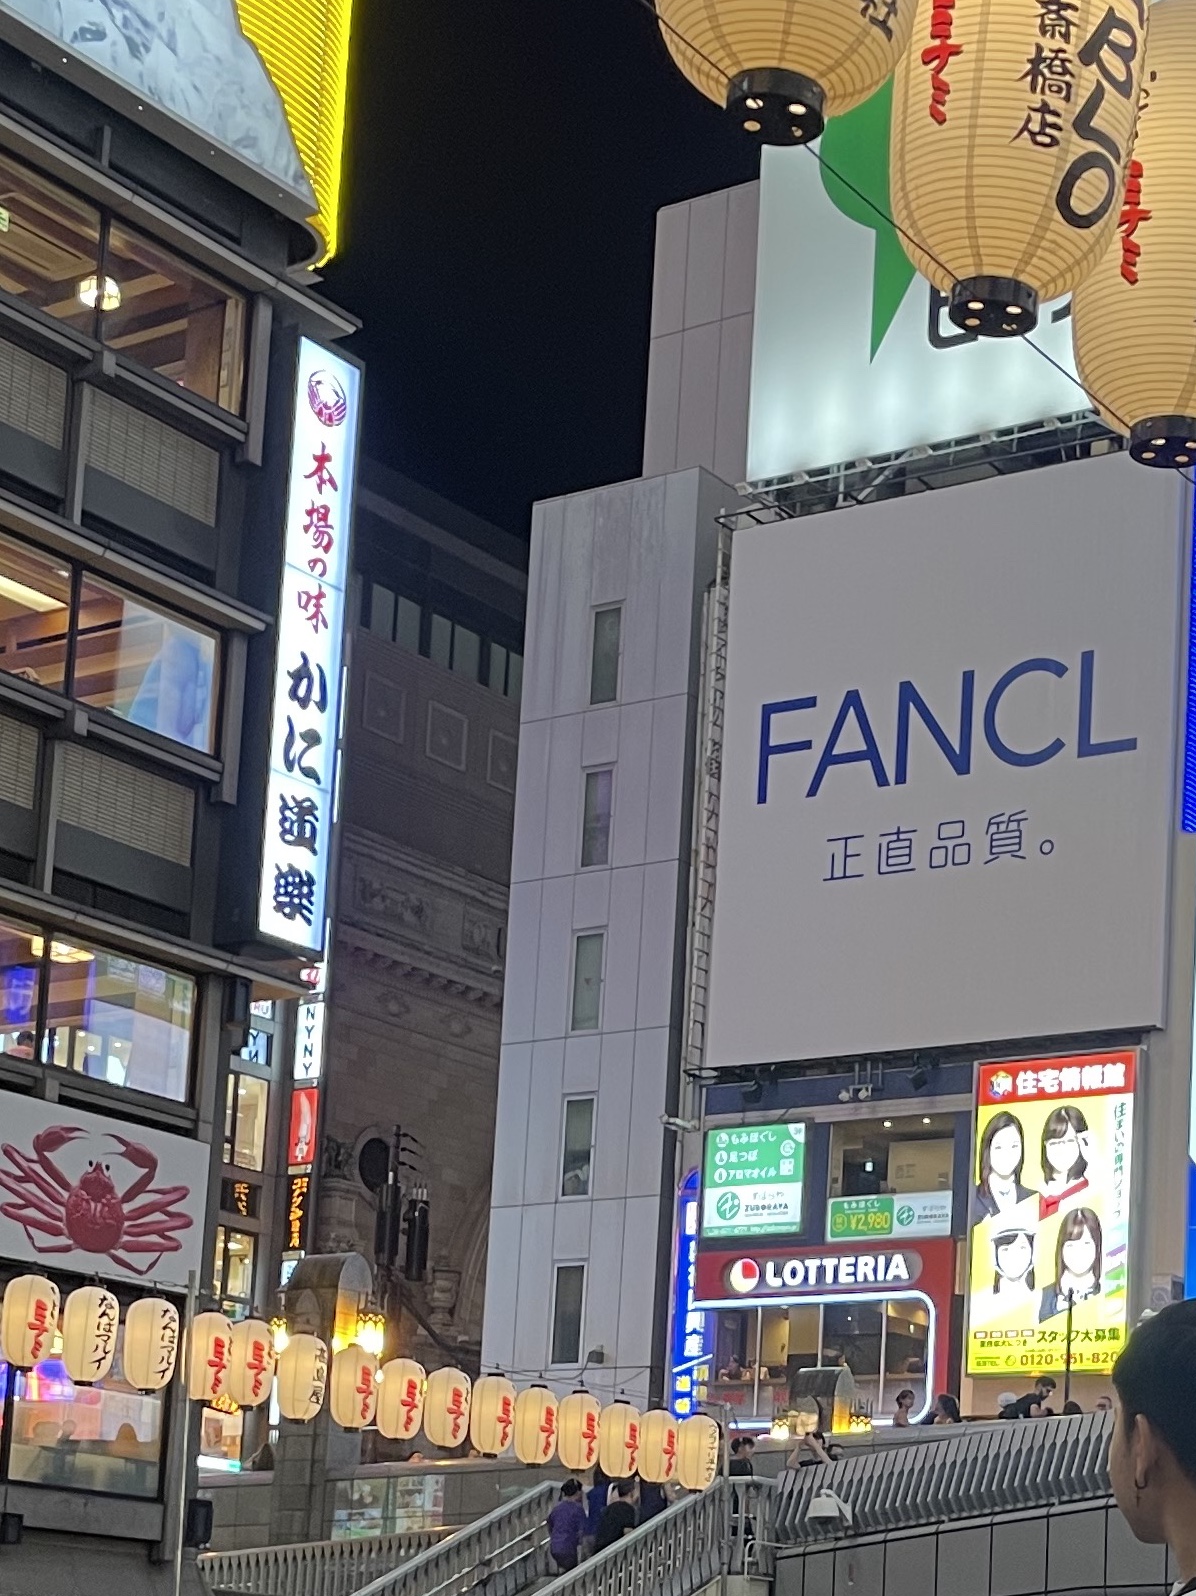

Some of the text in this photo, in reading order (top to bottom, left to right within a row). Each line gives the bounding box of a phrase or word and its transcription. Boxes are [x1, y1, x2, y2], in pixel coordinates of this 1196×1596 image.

[1055, 0, 1145, 229] BLO
[297, 441, 339, 634] 本場の味
[756, 649, 1138, 805] FANCL
[822, 809, 1055, 882] 正直品質。
[300, 1005, 316, 1078] NYNY
[730, 1129, 778, 1146] もみほぐし
[726, 1166, 778, 1181] アロマオイル
[850, 1211, 891, 1231] ¥2,980
[765, 1252, 909, 1287] LOTTERIA
[1036, 1327, 1121, 1344] スタッフ大募集
